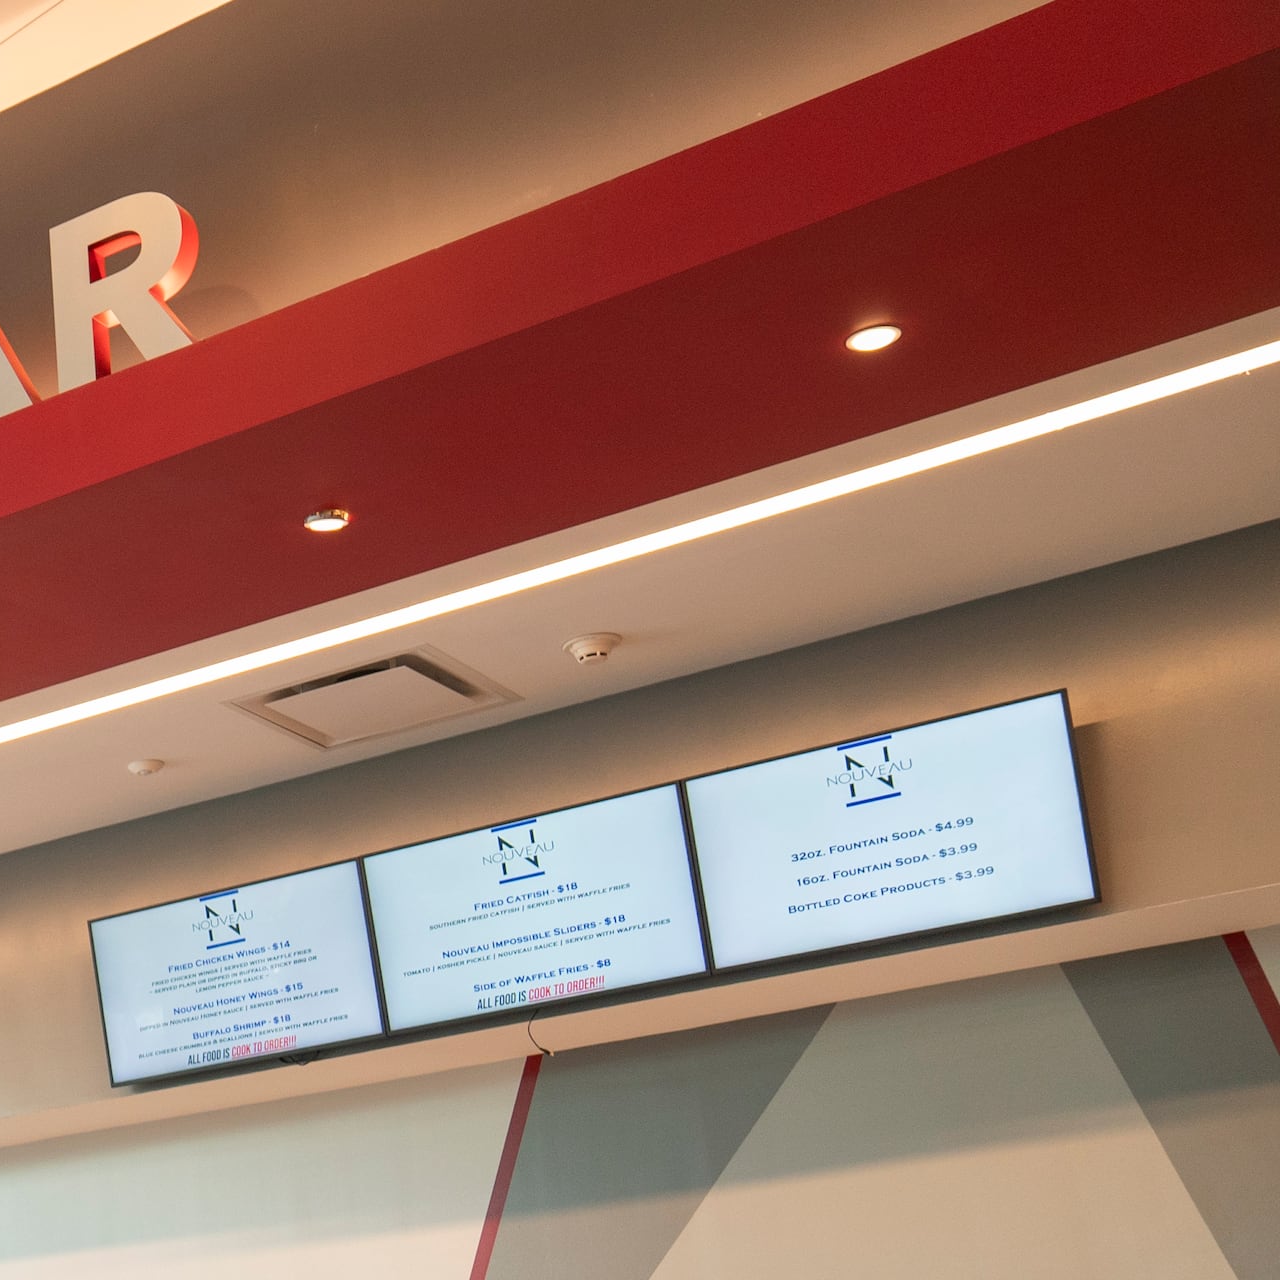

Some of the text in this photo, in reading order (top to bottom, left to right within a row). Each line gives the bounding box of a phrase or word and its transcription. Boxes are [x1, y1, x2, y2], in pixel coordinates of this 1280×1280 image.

[826, 758, 913, 787] NOUVEAU
[829, 834, 889, 855] FOUNTAIN
[892, 828, 926, 841] SODA
[935, 816, 974, 833] $4.99
[482, 840, 555, 866] NOUVEAU
[833, 860, 892, 880] FOUNTAIN
[895, 853, 929, 867] SODA
[939, 842, 978, 858] $3.99
[474, 900, 504, 911] FRIED
[506, 889, 549, 904] CATFISH
[557, 882, 578, 894] $18
[788, 897, 840, 914] BOTTLED
[843, 890, 877, 904] COKE
[880, 876, 946, 896] PRODUCTS
[955, 865, 995, 882] $3.99
[192, 910, 254, 933] NOUVEAU
[429, 919, 466, 930] SOUTHERN
[468, 914, 489, 922] FRIED
[490, 907, 520, 918] CATFISH
[527, 900, 555, 909] SERVED
[557, 896, 575, 904] WITH
[577, 888, 607, 898] WAFFLE
[608, 883, 630, 892] FRIES
[442, 944, 490, 958] NOUVEAU
[492, 930, 551, 949] IMPOSSIBLE
[554, 922, 596, 936] SLIDERS
[604, 914, 626, 926] $18
[168, 962, 194, 973] FRIED
[196, 952, 234, 967] CHICKEN
[236, 946, 266, 958] WINGS
[272, 940, 290, 950] $14
[474, 982, 496, 992] SIDE
[498, 979, 511, 988] OF
[514, 970, 556, 984] WAFFLE
[558, 964, 589, 976] FRIES
[596, 959, 611, 968] $8
[173, 1001, 214, 1015] NOUVEAU
[216, 994, 246, 1006] HONEY
[248, 988, 279, 1000] WINGS
[285, 982, 304, 992] $15
[477, 976, 605, 1010] ALL FOOD IS COOK TO ORDER!!!
[192, 1026, 231, 1040] BUFFALO
[233, 1020, 267, 1032] SHRIMP
[273, 1014, 291, 1024] $18
[188, 1035, 297, 1066] ALL FOOD IS COOK TO ORDER!!!
